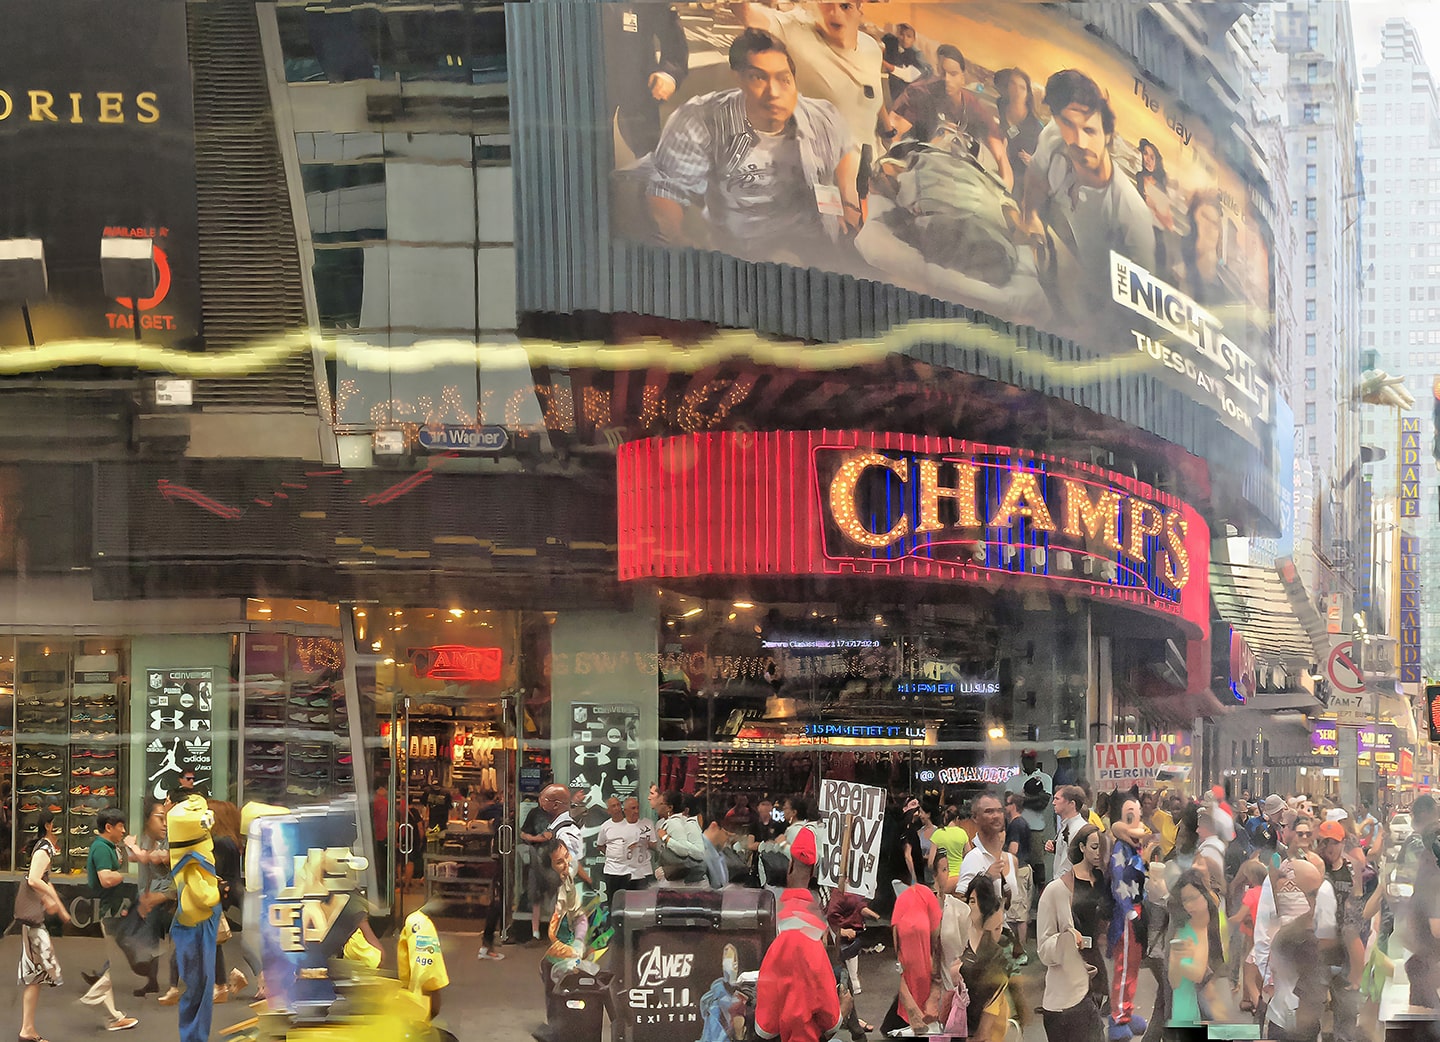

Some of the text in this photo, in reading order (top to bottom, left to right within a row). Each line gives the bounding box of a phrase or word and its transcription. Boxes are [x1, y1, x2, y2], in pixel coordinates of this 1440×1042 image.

[1133, 76, 1161, 114] The
[1117, 263, 1128, 296] THE
[448, 429, 500, 448] Wagner
[1402, 418, 1418, 516] MADAME
[830, 452, 1190, 590] CHAMPS
[975, 540, 1117, 581] SPORTS
[1402, 538, 1418, 682] TUSSAUDS
[183, 755, 211, 763] adidas
[1095, 743, 1168, 768] TATTOO
[1100, 768, 1159, 779] PIERCIN
